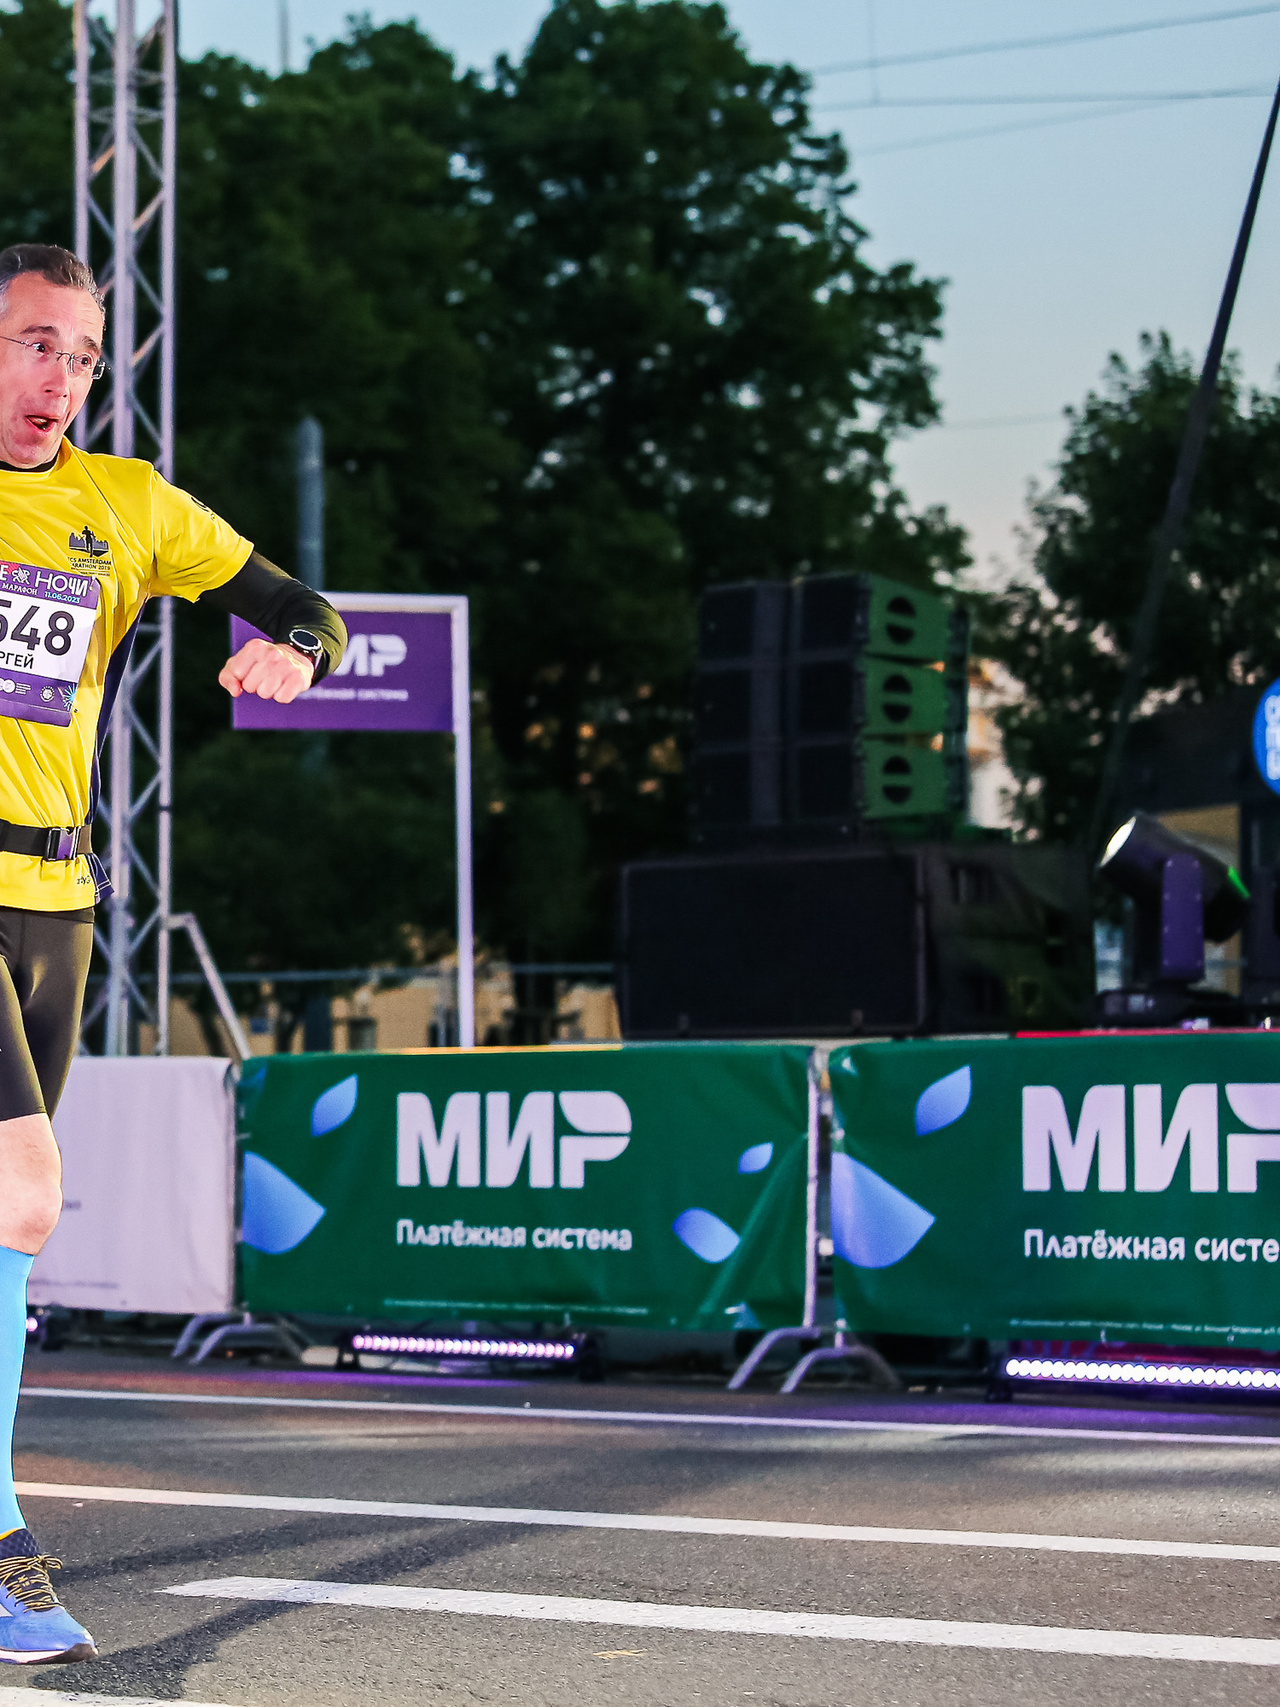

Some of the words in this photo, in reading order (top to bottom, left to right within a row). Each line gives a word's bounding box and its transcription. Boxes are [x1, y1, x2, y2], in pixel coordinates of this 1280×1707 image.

[77, 558, 112, 566] AMSTERDAM
[1, 583, 38, 596] МАРАФОН
[35, 571, 89, 597] НОЧИ
[44, 591, 81, 604] 11.06.2023
[332, 633, 408, 677] ИР
[396, 1091, 632, 1189] МИР
[397, 1218, 526, 1247] Платёжная
[532, 1227, 633, 1251] система
[1024, 1228, 1186, 1261] Платёжная
